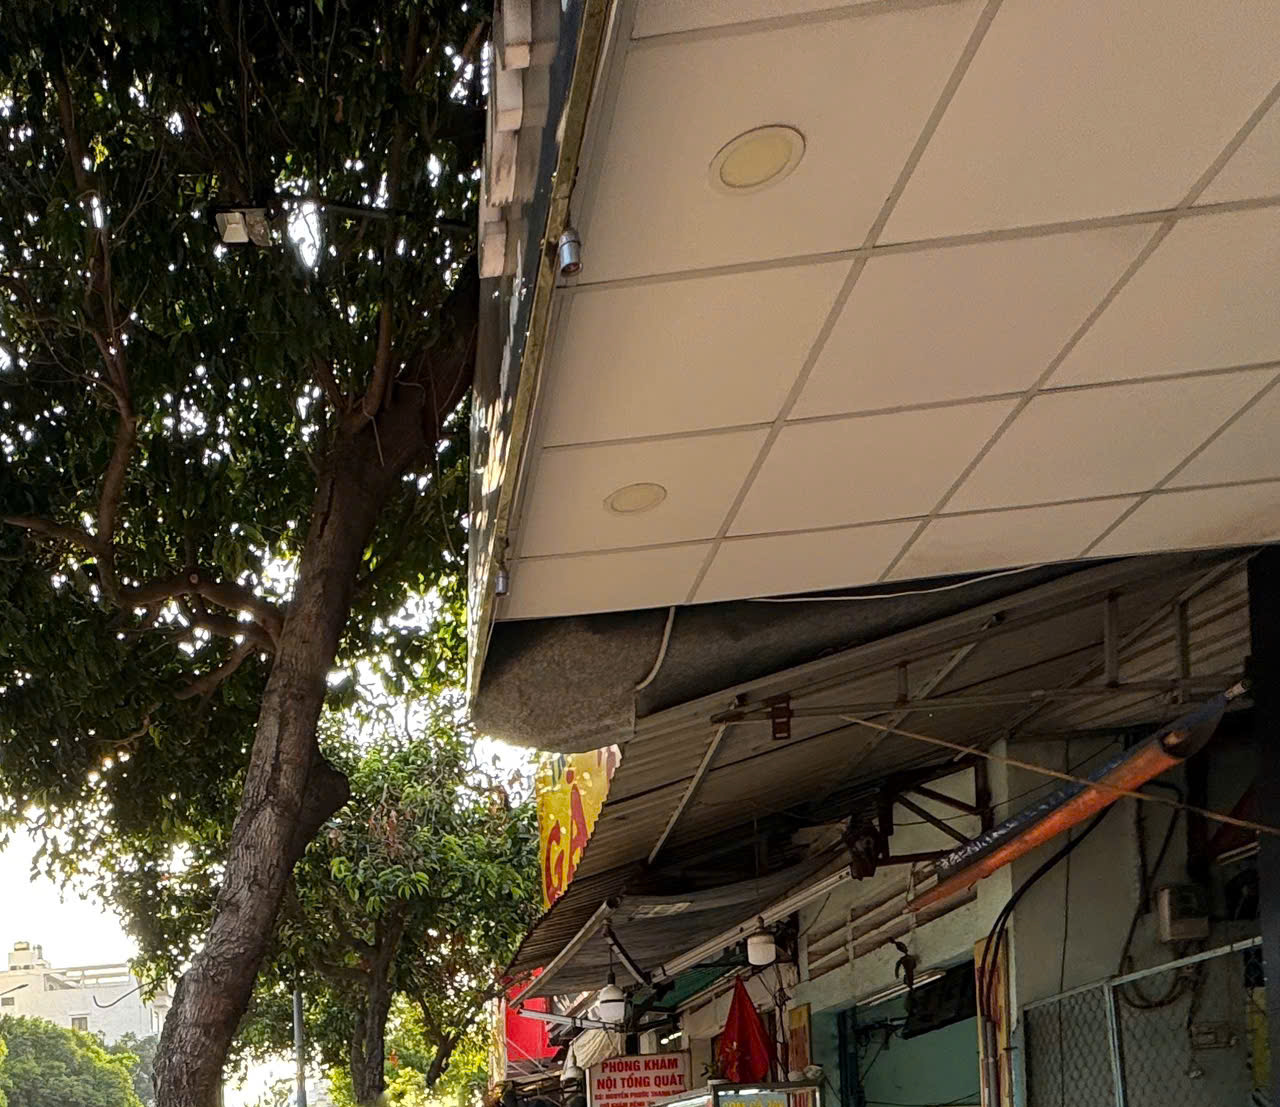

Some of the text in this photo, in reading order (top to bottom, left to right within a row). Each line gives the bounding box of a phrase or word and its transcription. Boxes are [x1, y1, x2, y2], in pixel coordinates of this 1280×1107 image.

[601, 1057, 679, 1073] PHÒNG KHÁM
[597, 1076, 617, 1092] NỘI
